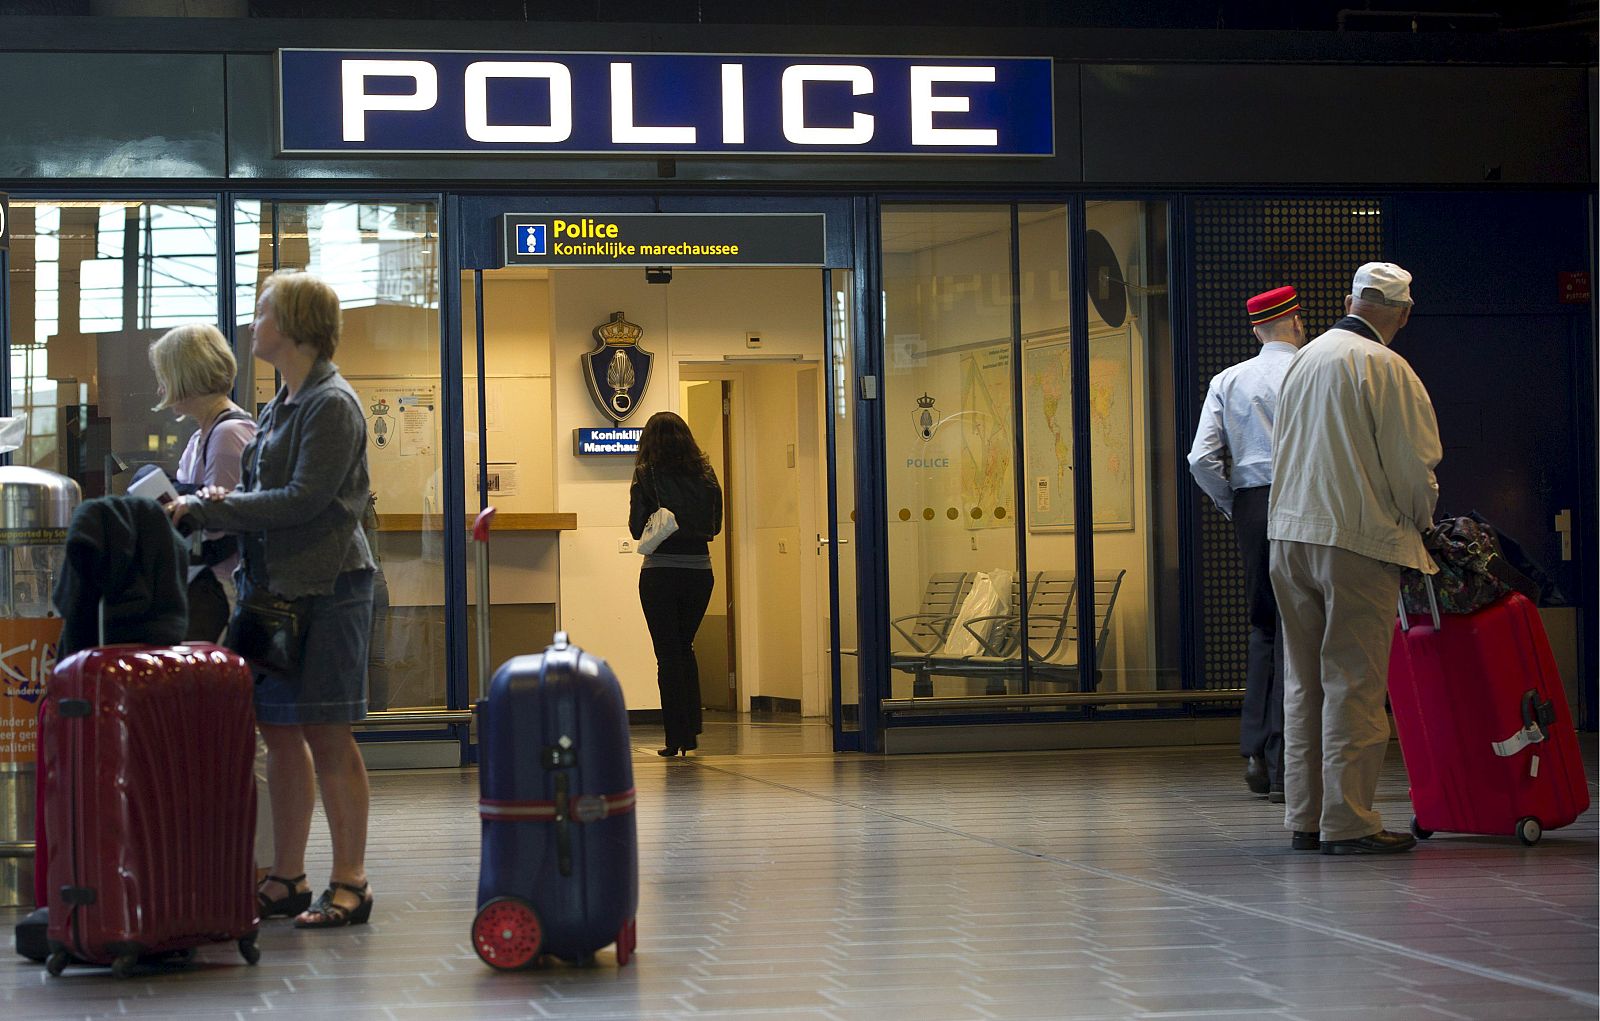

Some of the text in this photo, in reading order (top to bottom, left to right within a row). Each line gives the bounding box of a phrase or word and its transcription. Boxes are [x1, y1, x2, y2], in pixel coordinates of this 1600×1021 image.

[341, 59, 998, 146] POLICE
[553, 219, 619, 239] Police
[554, 242, 739, 258] Koninklijke marechaussee
[906, 458, 949, 468] POLICE
[0, 529, 42, 541] upported
